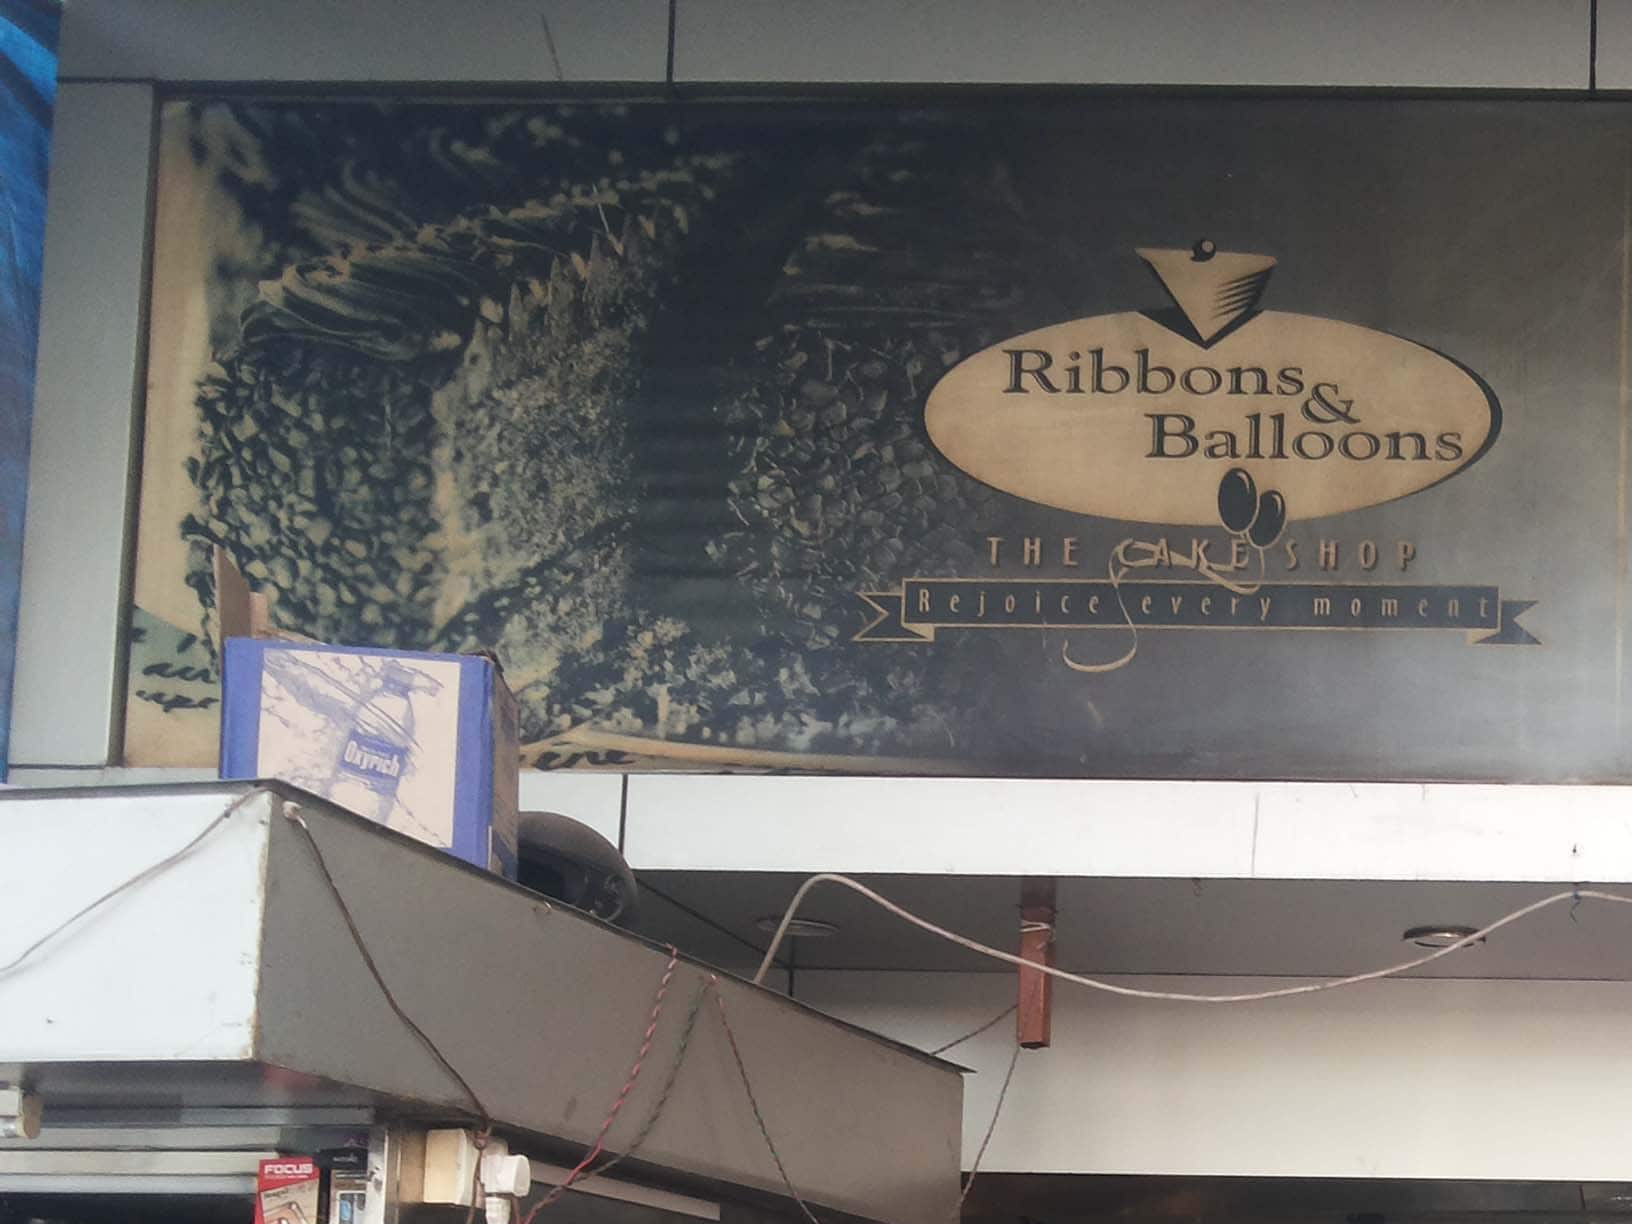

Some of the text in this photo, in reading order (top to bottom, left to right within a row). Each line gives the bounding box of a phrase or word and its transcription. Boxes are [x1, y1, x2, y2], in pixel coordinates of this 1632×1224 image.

[1001, 347, 1362, 425] Ribbons &
[1143, 411, 1464, 462] Balloons
[986, 535, 1080, 568] THE
[1286, 538, 1417, 572] SHOP
[917, 587, 1493, 621] Rejoice every moment
[264, 1163, 313, 1175] FOCUS
